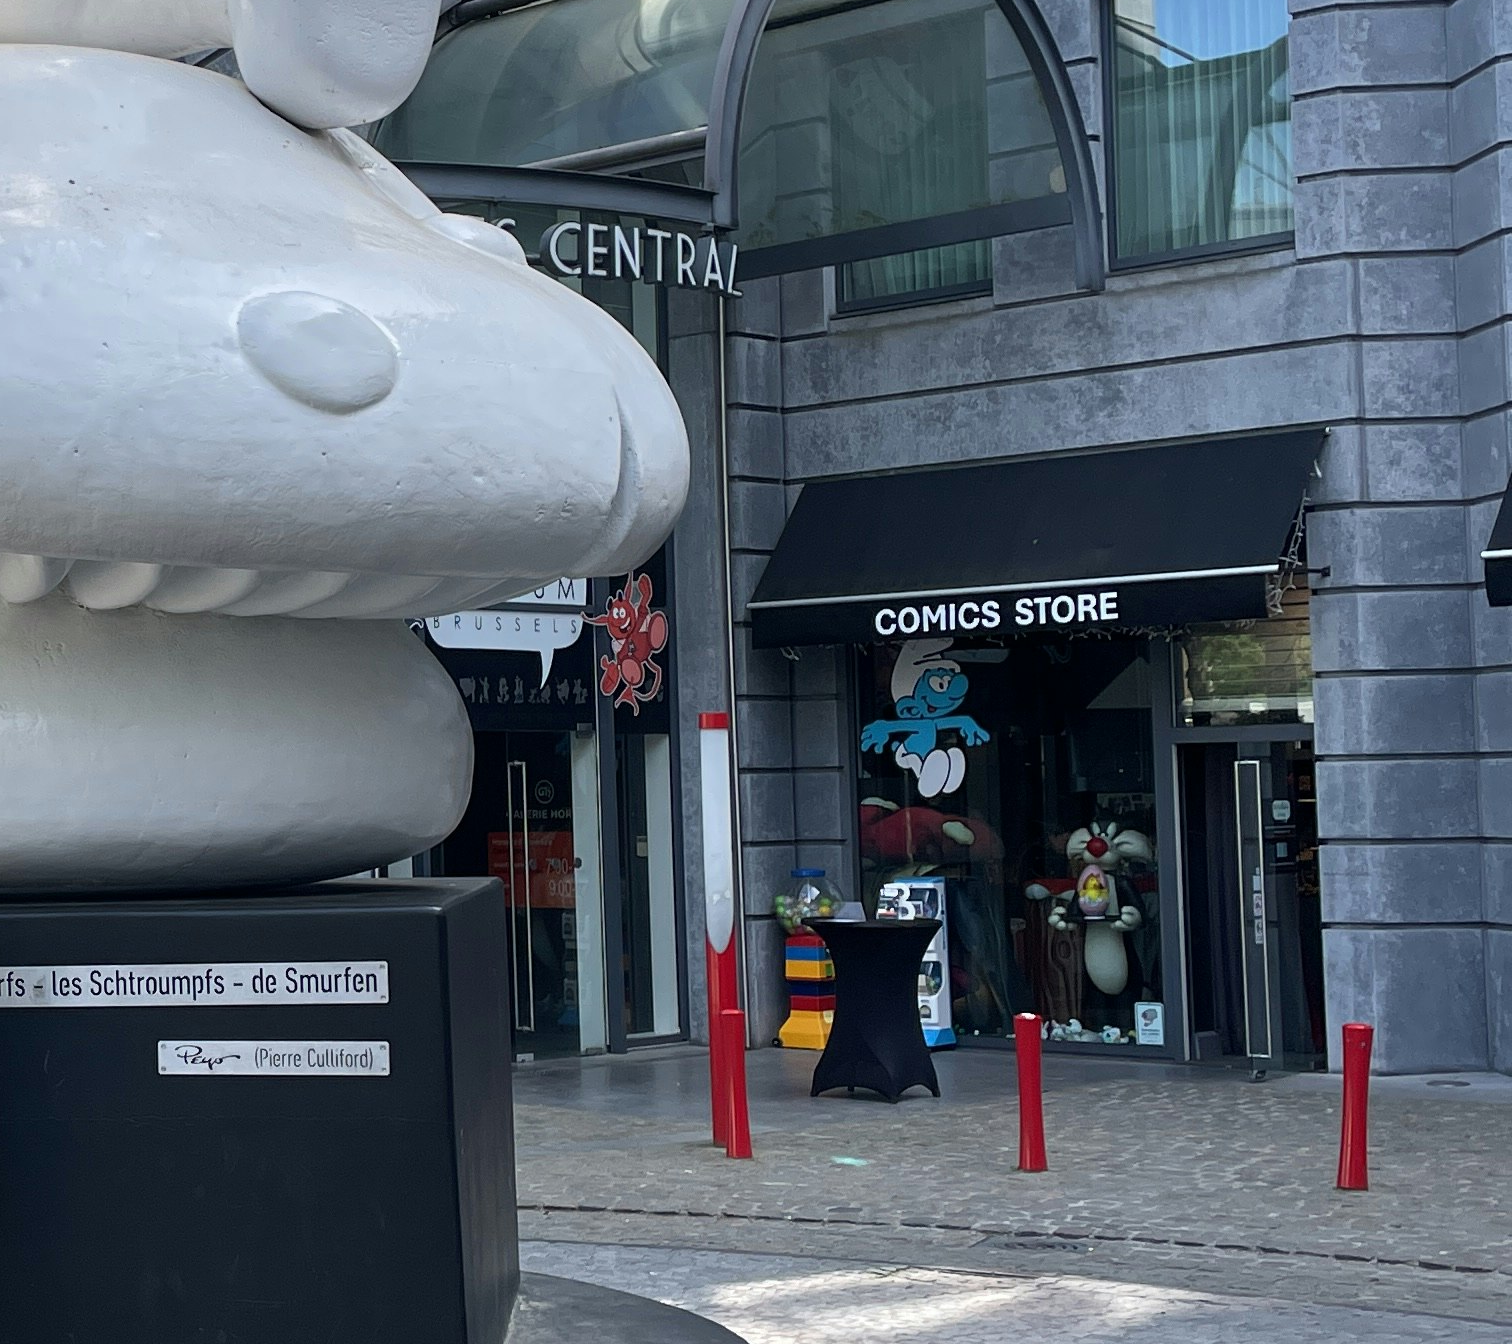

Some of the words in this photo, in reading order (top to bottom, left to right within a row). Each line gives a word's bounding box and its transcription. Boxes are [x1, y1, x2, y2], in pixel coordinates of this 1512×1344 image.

[550, 221, 743, 296] CENTRAL
[433, 615, 577, 634] BRUSSELS
[875, 600, 1000, 635] COMICS
[1015, 592, 1118, 626] STORE
[52, 970, 82, 996] les
[90, 968, 225, 1001] Schtroumpfs
[252, 968, 277, 993] de
[285, 967, 378, 993] Smurfen
[254, 1047, 301, 1069] (Pierre
[307, 1047, 374, 1070] Culliford)
